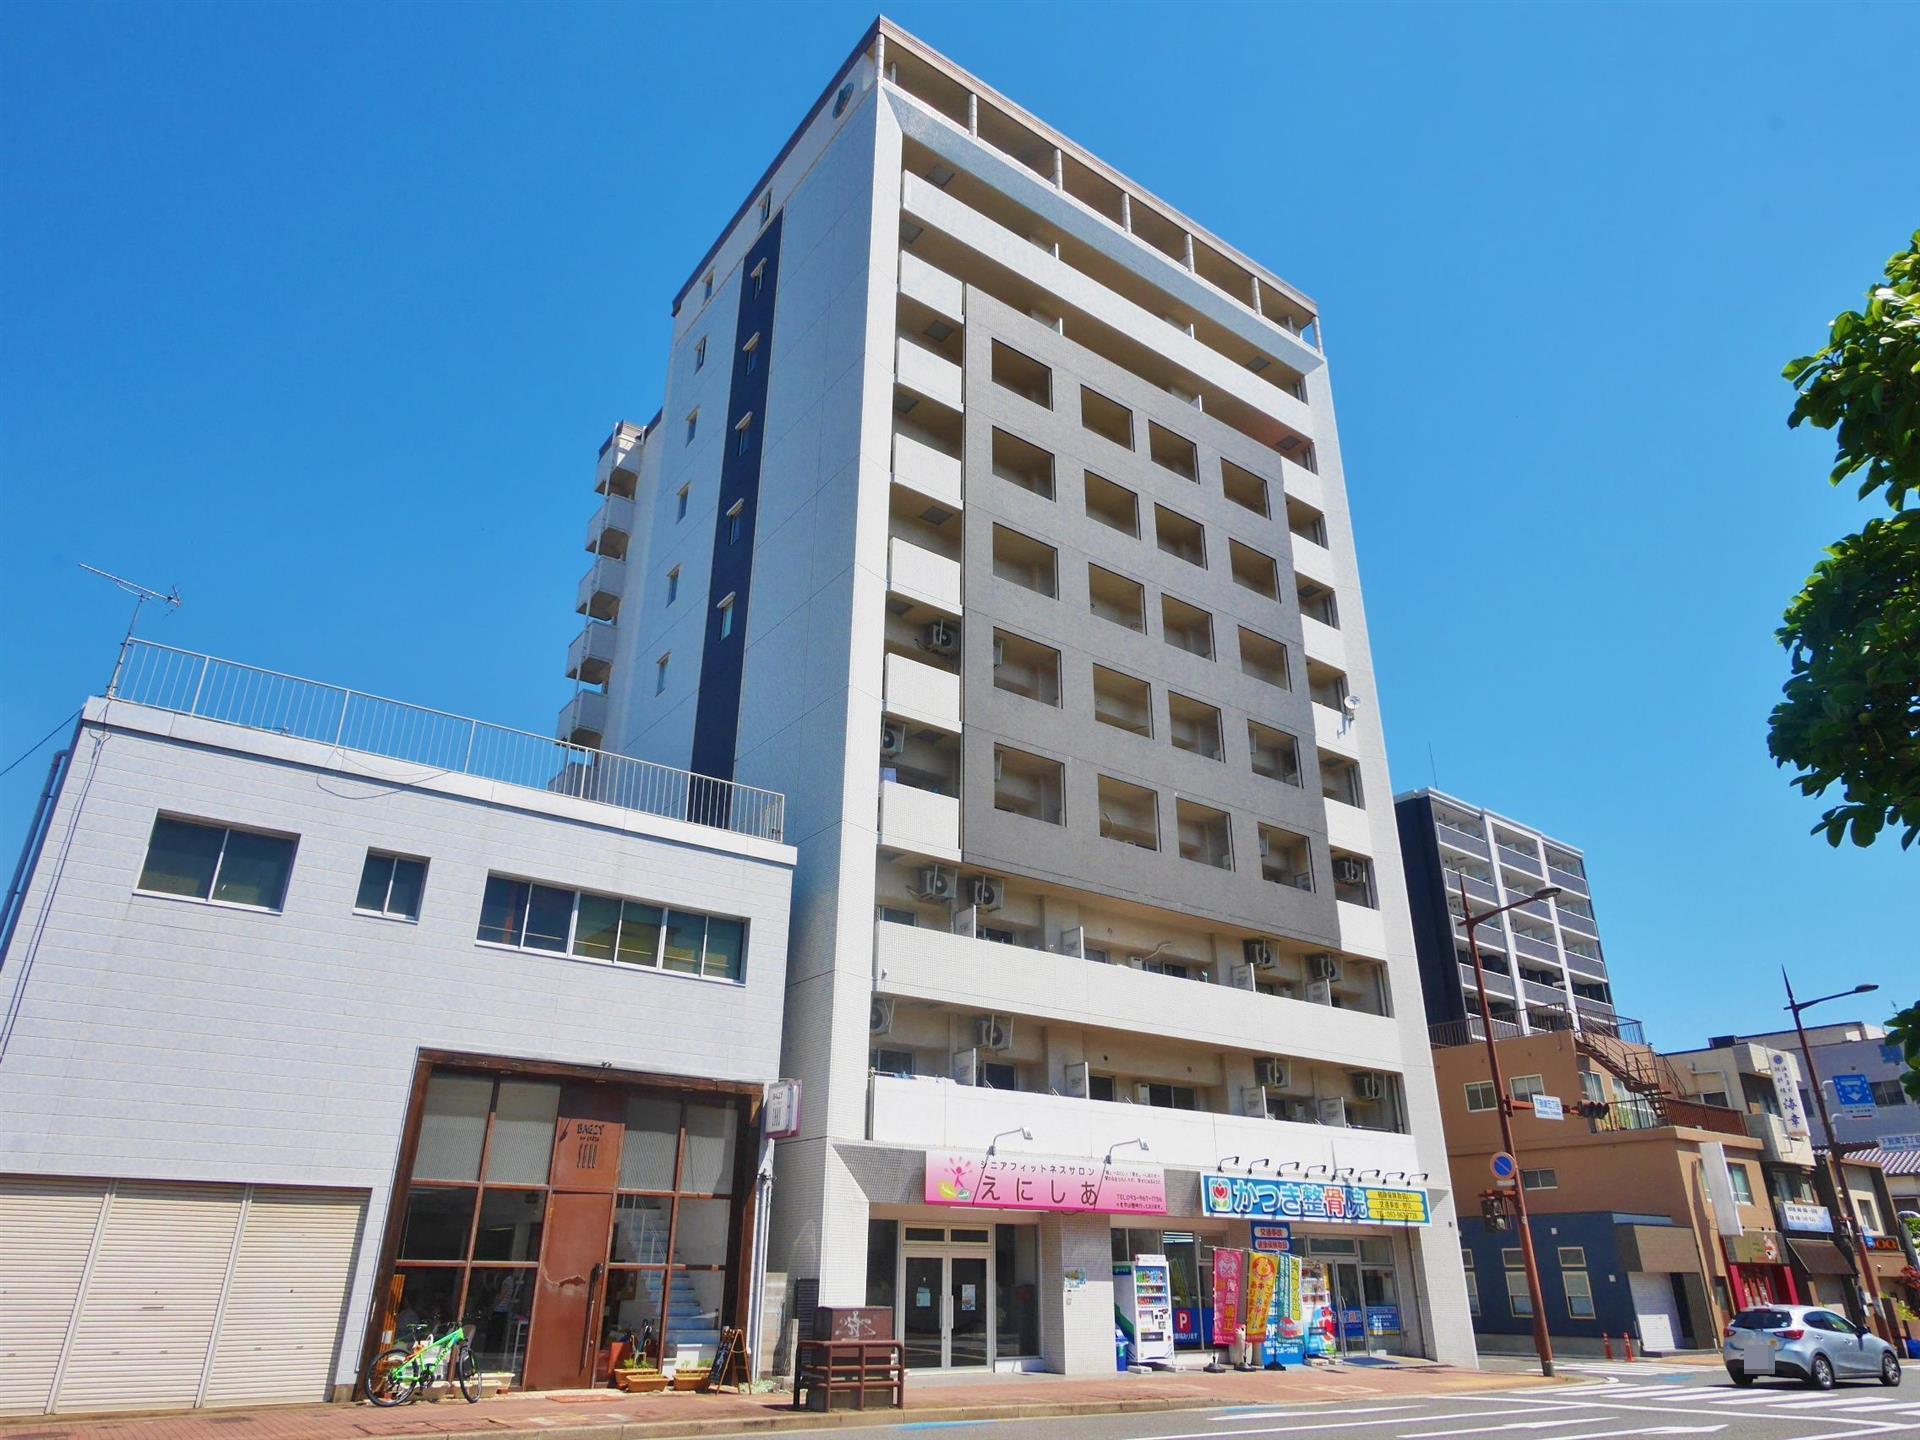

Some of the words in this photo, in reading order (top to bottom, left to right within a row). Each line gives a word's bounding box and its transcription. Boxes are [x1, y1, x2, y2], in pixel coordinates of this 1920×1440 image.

[980, 1160, 1095, 1176] シニアフィットネスサロン
[981, 1175, 1098, 1206] えにしあ
[1232, 1179, 1368, 1219] かつき整骨院
[1179, 1312, 1187, 1329] P
